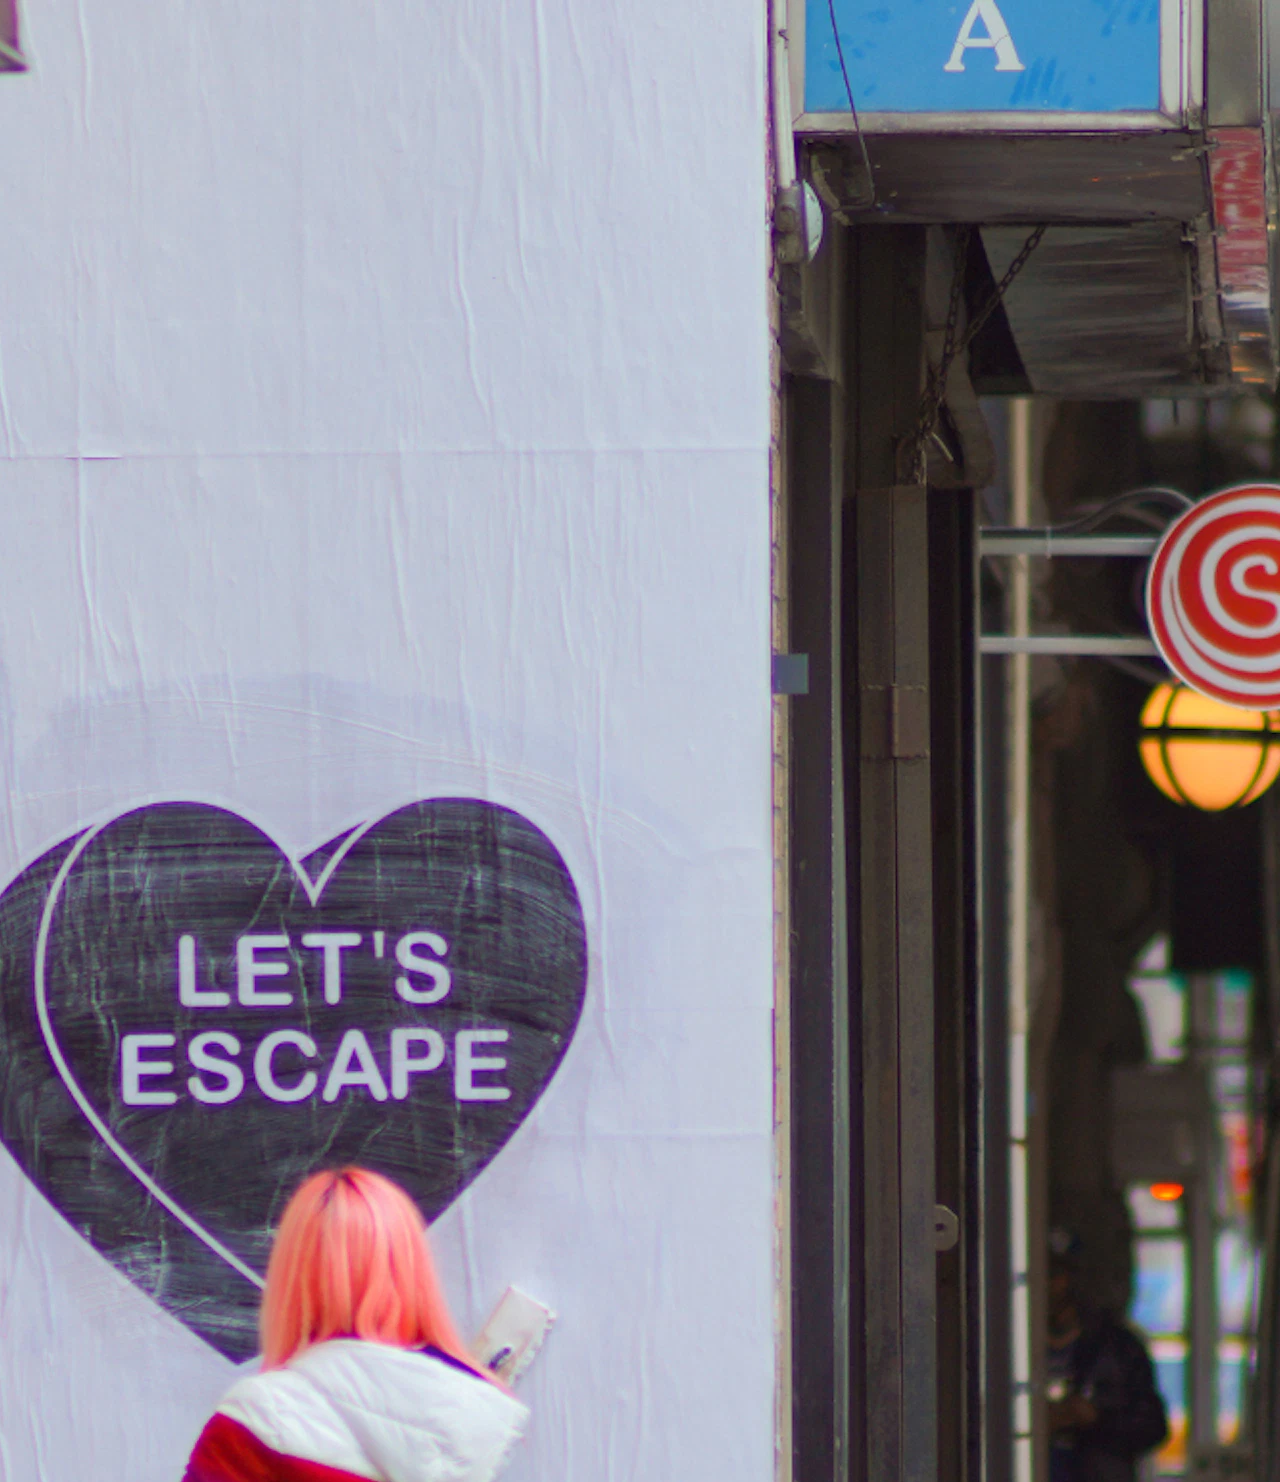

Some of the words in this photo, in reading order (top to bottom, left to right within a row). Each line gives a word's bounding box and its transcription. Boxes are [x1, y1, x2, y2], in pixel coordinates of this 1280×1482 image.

[943, 0, 1026, 72] A
[178, 931, 452, 1007] LET'S
[121, 1027, 511, 1105] ESCAPE
